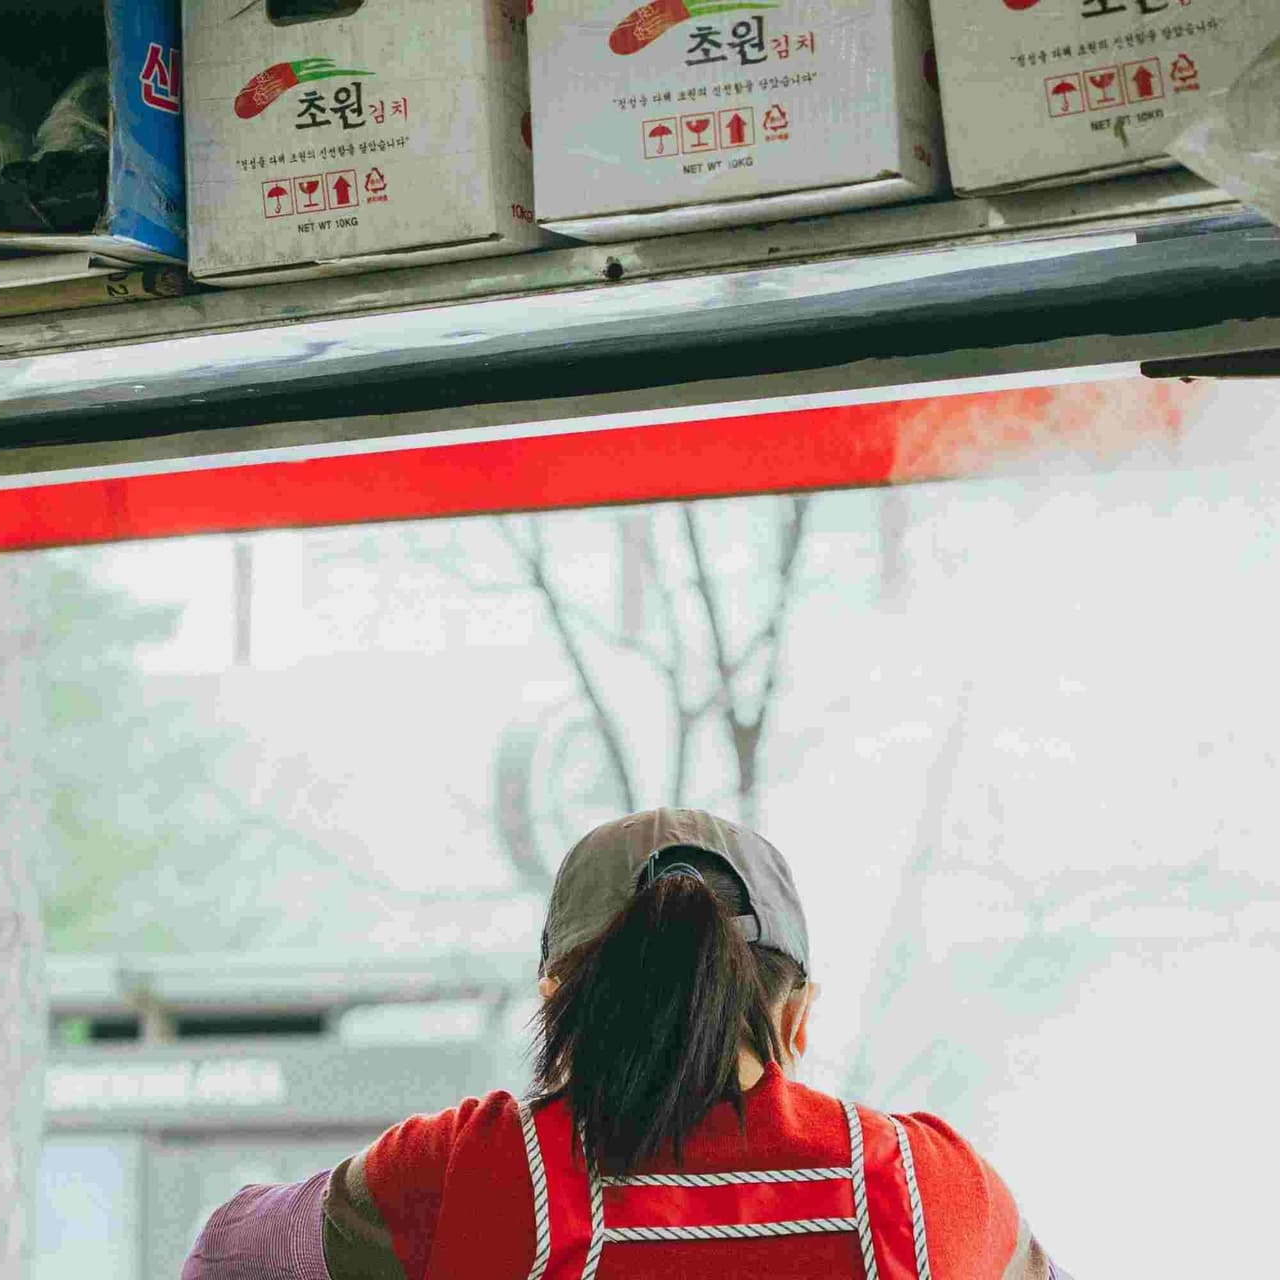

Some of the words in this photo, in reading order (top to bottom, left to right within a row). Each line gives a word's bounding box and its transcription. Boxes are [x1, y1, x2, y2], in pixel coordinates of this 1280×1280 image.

[684, 16, 768, 66] 초원
[771, 32, 815, 60] 김치
[295, 82, 366, 130] 초원
[369, 97, 408, 124] 김치
[1090, 119, 1111, 131] NET
[683, 163, 703, 175] NET
[707, 161, 722, 173] WT
[728, 157, 754, 170] 10KG
[298, 222, 315, 234] NET
[318, 220, 332, 231] WT
[335, 217, 359, 229] 10KG
